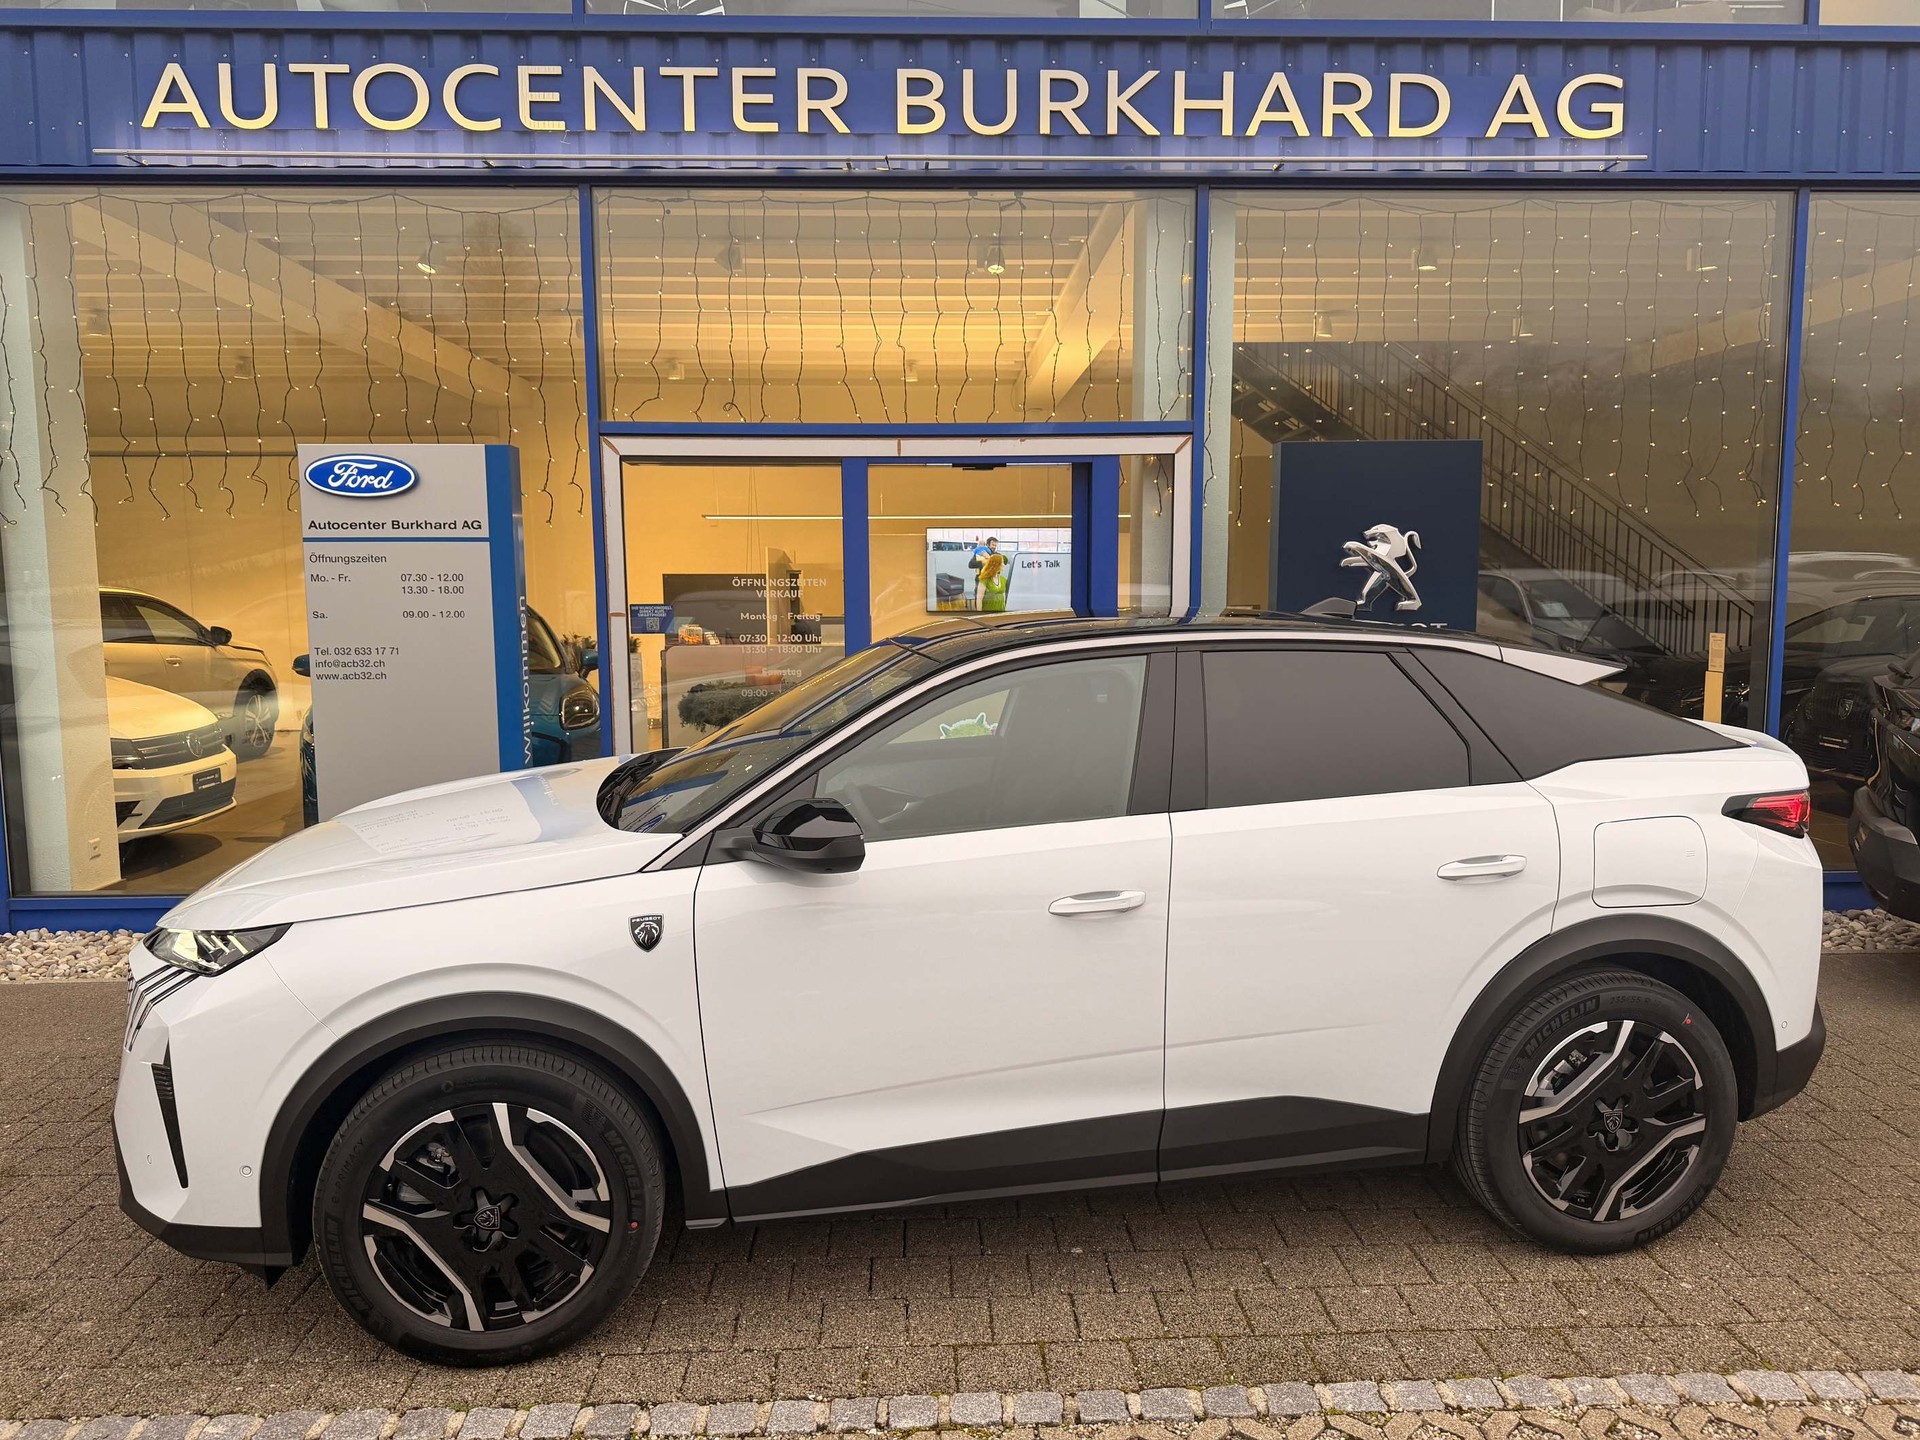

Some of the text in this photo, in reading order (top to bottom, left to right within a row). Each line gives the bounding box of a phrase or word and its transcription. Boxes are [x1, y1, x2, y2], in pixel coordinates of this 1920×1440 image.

[141, 62, 1625, 139] AUTOCENTER BURKHARD AG
[328, 462, 394, 489] Ford
[308, 519, 482, 530] Autocenter Burkhard AG
[309, 552, 387, 565] Öffnungszeiten
[1021, 560, 1061, 569] Let's Talk
[310, 573, 329, 582] Mo.
[338, 574, 351, 582] Fr.
[400, 573, 428, 582] 07.30
[437, 573, 464, 582] 12.00
[732, 576, 827, 587] ÖFFNUNGSZEITEN
[401, 586, 428, 595] 13.30
[438, 586, 465, 595] 18.00
[756, 589, 803, 598] VERKAUF
[312, 611, 328, 619] Sa.
[402, 610, 429, 619] 09.00
[440, 610, 465, 619] 12.00
[787, 612, 821, 621] Freitag
[739, 634, 767, 643] 07:30
[776, 634, 803, 643] 12:00
[805, 634, 823, 643] Uhr
[314, 647, 399, 656] Tel. 032 633 17 71
[741, 645, 767, 654] 13:30
[777, 645, 803, 654] 18:00
[805, 645, 823, 654] Uhr
[315, 659, 386, 668] info@acb32.ch
[315, 671, 387, 680] www.acb32.ch
[741, 689, 768, 697] 09:00
[1525, 998, 1598, 1055] MICHELIN
[604, 1129, 643, 1219] MICHELIN
